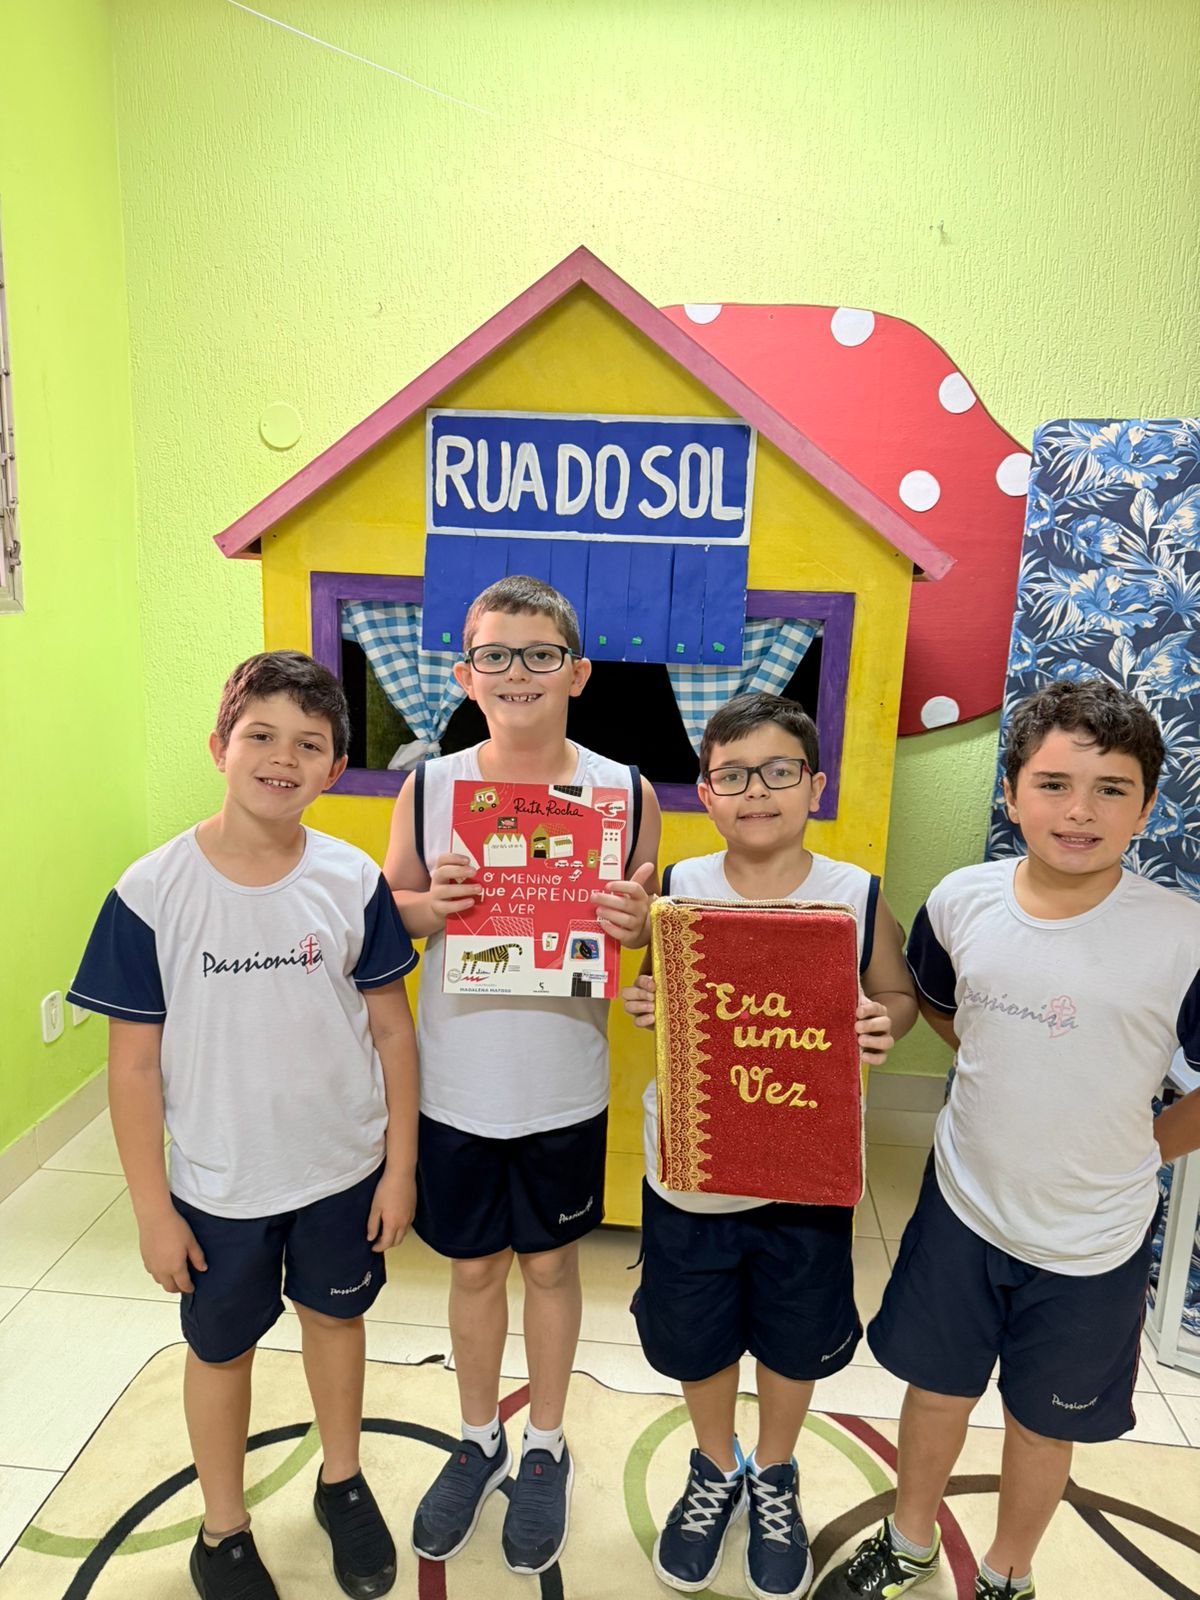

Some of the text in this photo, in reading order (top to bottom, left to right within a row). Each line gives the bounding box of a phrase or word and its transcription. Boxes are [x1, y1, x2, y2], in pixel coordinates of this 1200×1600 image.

[435, 435, 744, 520] RUA DO SOL
[513, 797, 584, 817] Ruth Rocha
[483, 872, 563, 885] O MENINO
[511, 887, 614, 902] APREND
[490, 903, 536, 915] A VER
[705, 982, 792, 1020] Era
[733, 1026, 833, 1051] uma
[730, 1065, 818, 1109] Vez.
